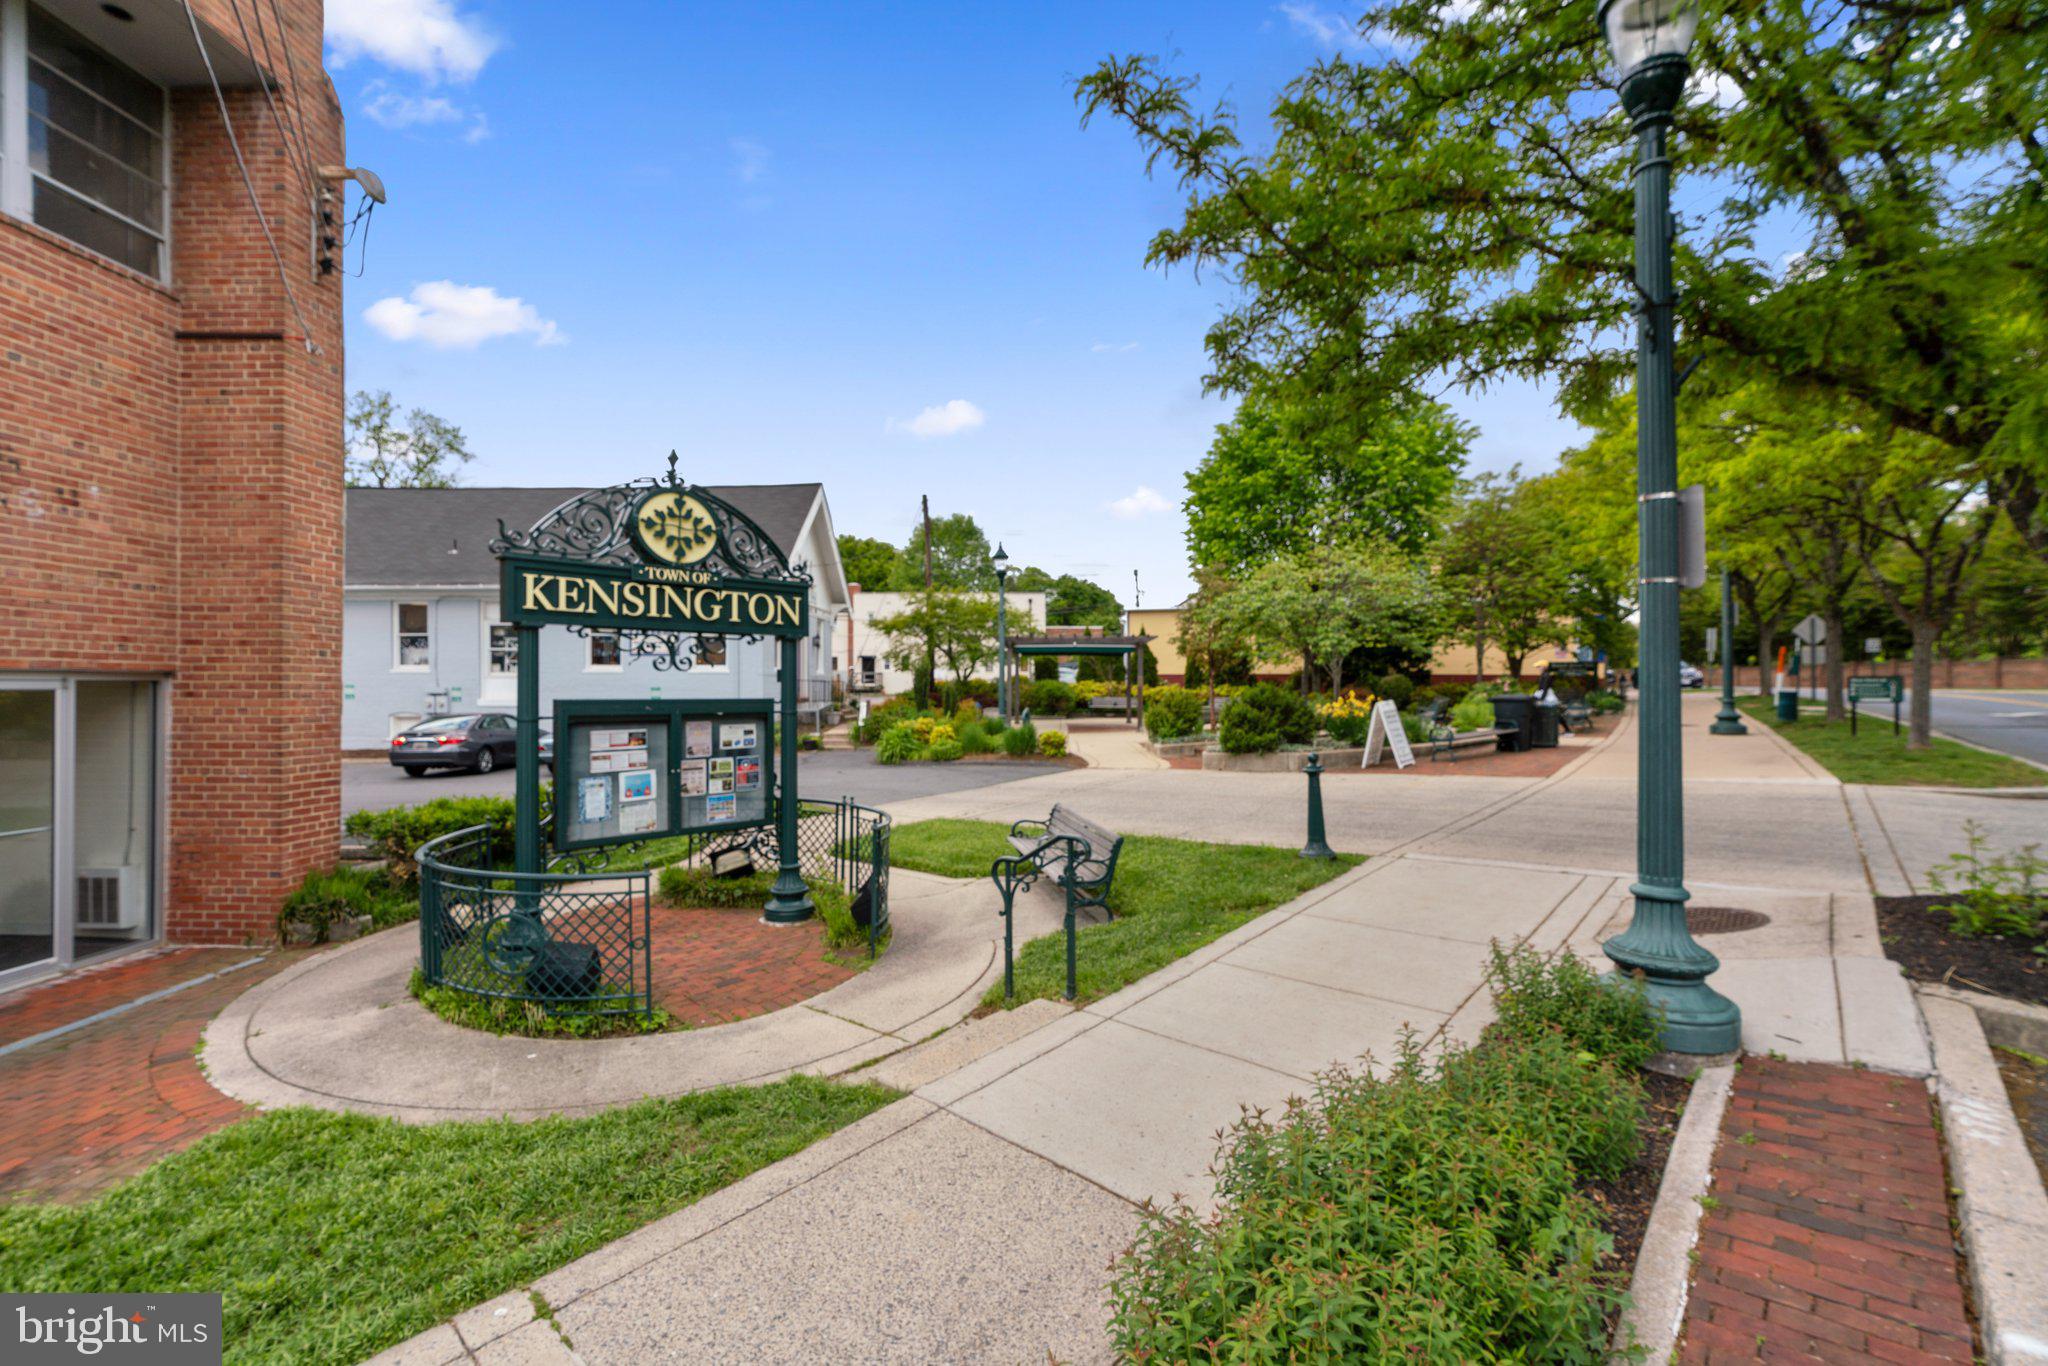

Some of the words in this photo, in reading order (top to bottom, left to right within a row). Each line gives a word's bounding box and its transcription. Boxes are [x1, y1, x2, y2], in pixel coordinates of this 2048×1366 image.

[644, 566, 690, 583] TOWN
[692, 571, 712, 585] OF
[522, 573, 802, 627] KENSINGTON
